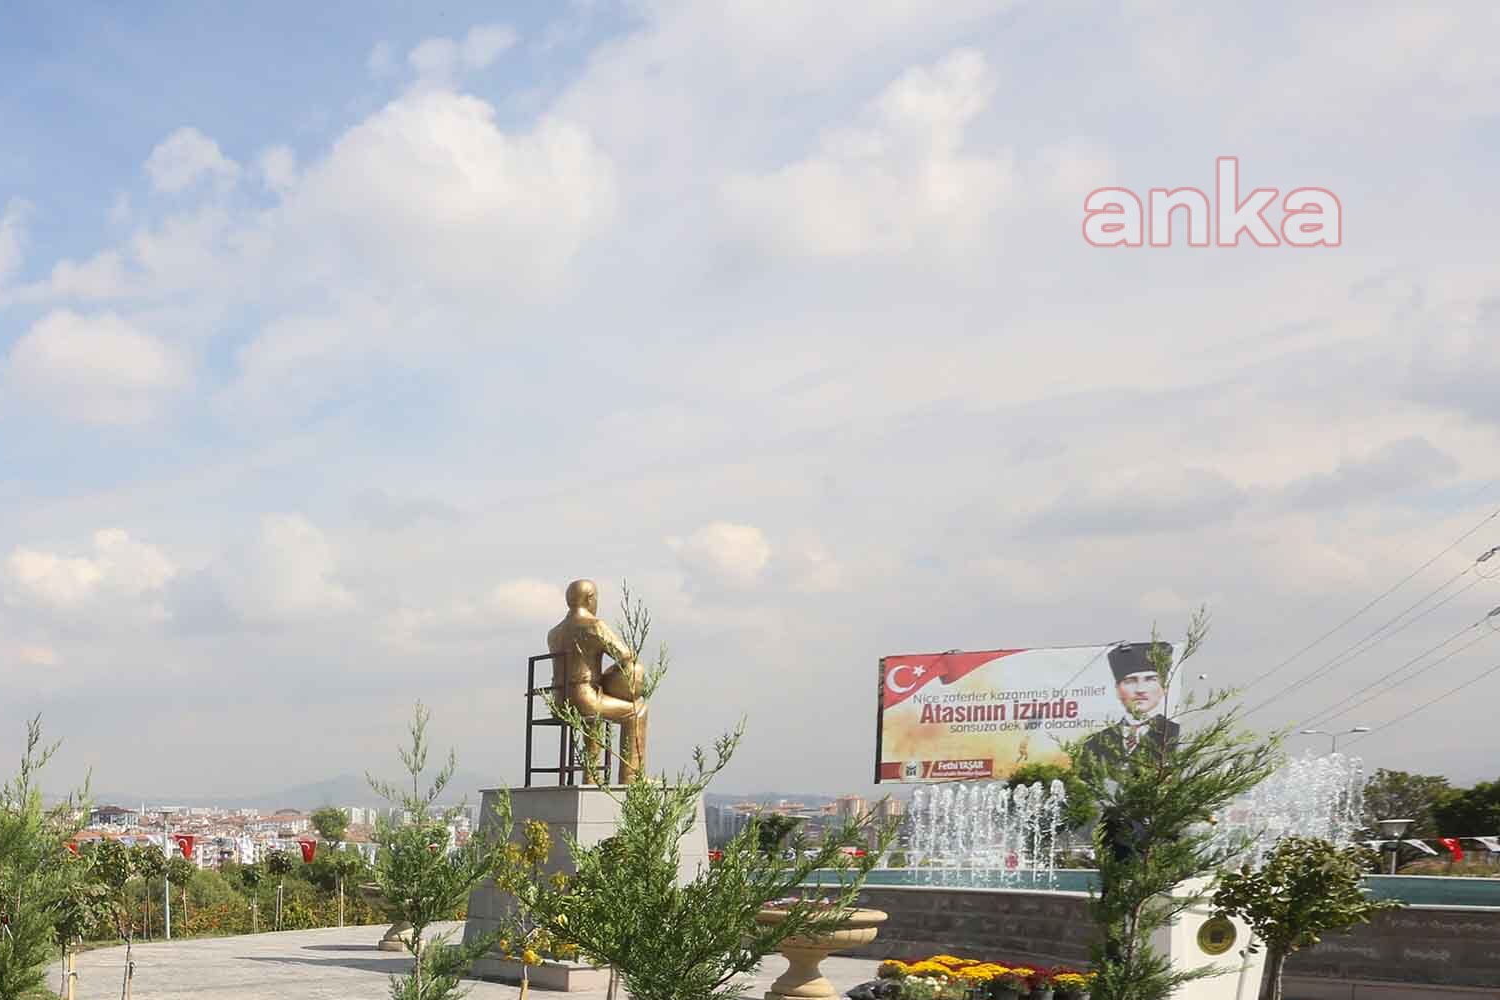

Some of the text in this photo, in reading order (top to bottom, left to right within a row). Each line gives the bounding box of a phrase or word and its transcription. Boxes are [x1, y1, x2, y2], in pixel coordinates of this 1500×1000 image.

[913, 694, 940, 704] Nice
[943, 691, 988, 703] zaferler
[1052, 687, 1068, 698] bu
[1071, 686, 1106, 696] millet
[920, 703, 1006, 724] Atasının
[950, 723, 997, 733] sonsuza
[999, 721, 1020, 731] dek
